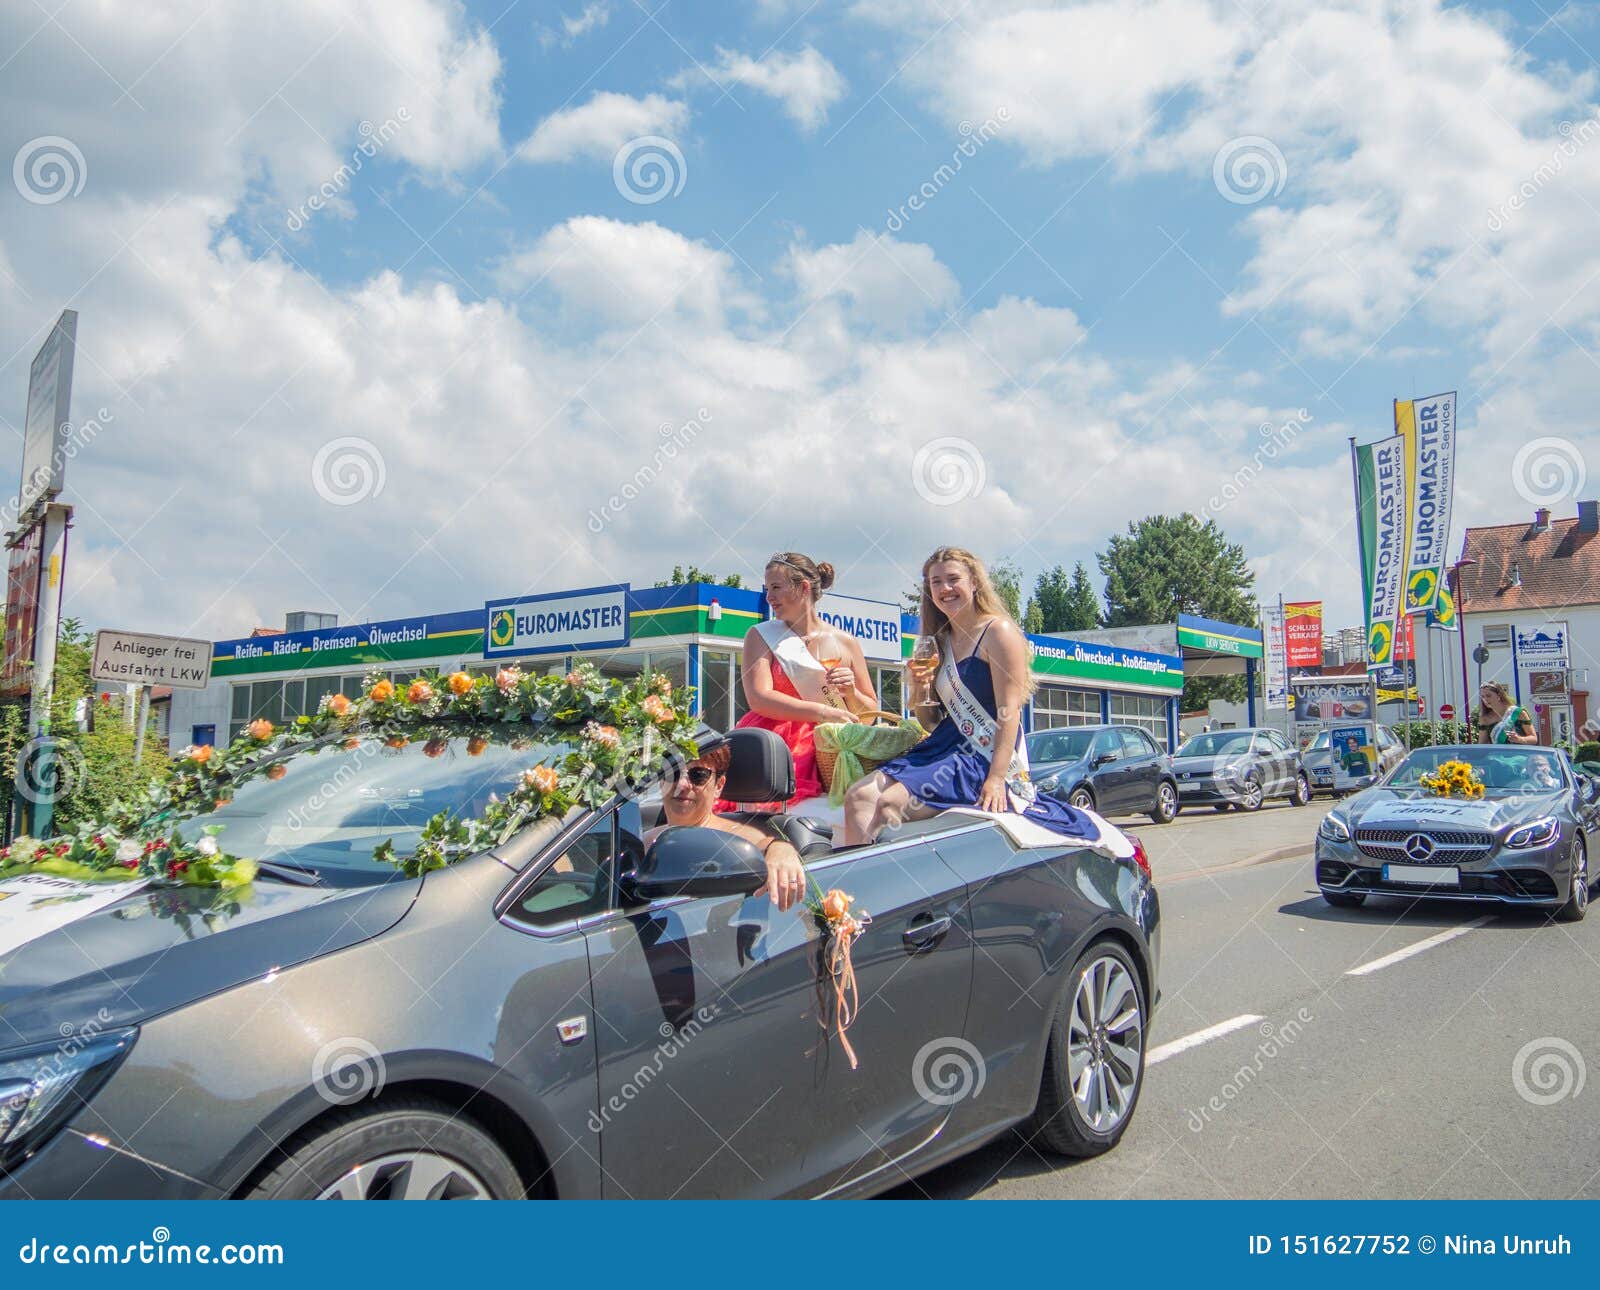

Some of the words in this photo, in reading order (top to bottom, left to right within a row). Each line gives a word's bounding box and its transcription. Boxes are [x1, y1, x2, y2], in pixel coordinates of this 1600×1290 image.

[1441, 399, 1450, 450] Service.
[1411, 403, 1438, 565] EUROMASTER
[1372, 446, 1394, 618] EUROMASTER
[516, 604, 622, 636] EUROMASTER
[1288, 624, 1319, 632] SCHLUSS
[1288, 631, 1319, 640] VERKAUF
[112, 640, 169, 657] Anlieger
[174, 646, 196, 660] frei
[235, 644, 263, 659] Reifen
[273, 640, 302, 655] Räder
[312, 636, 357, 652] Bremsen
[369, 624, 427, 646] Ölwechsel
[1028, 640, 1066, 660] Bremsen
[1074, 644, 1115, 666] Ölwechsel
[1121, 654, 1167, 675] Stoßdämpfer
[1219, 638, 1240, 653] SERVICE
[100, 660, 164, 677] Ausfahrt
[170, 667, 204, 681] LKW
